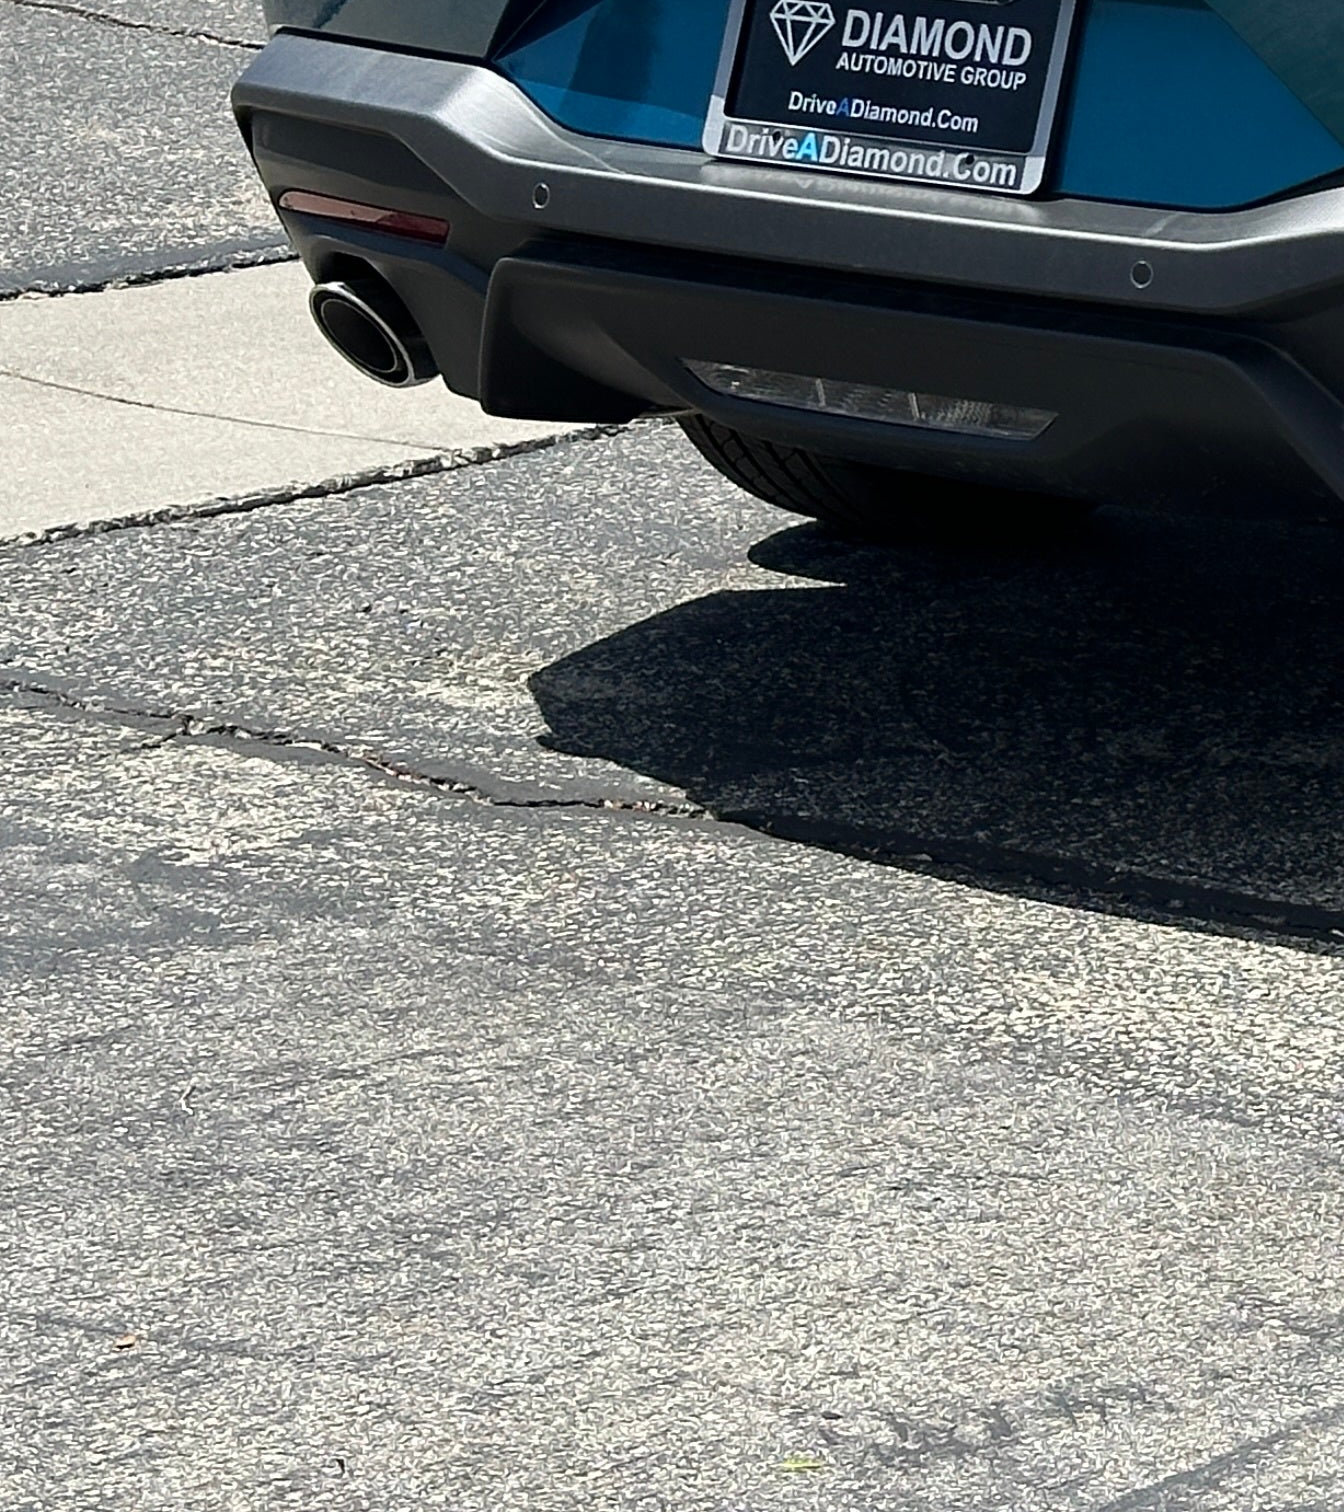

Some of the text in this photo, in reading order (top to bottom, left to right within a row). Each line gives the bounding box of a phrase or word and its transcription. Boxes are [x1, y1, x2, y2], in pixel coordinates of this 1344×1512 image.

[842, 9, 1032, 66] DIAMOND
[835, 51, 1027, 90] AUTOMOTIVE GROUP
[787, 91, 979, 133] DriveADiamond.Com
[725, 123, 1017, 187] DriveADiamond.Com
